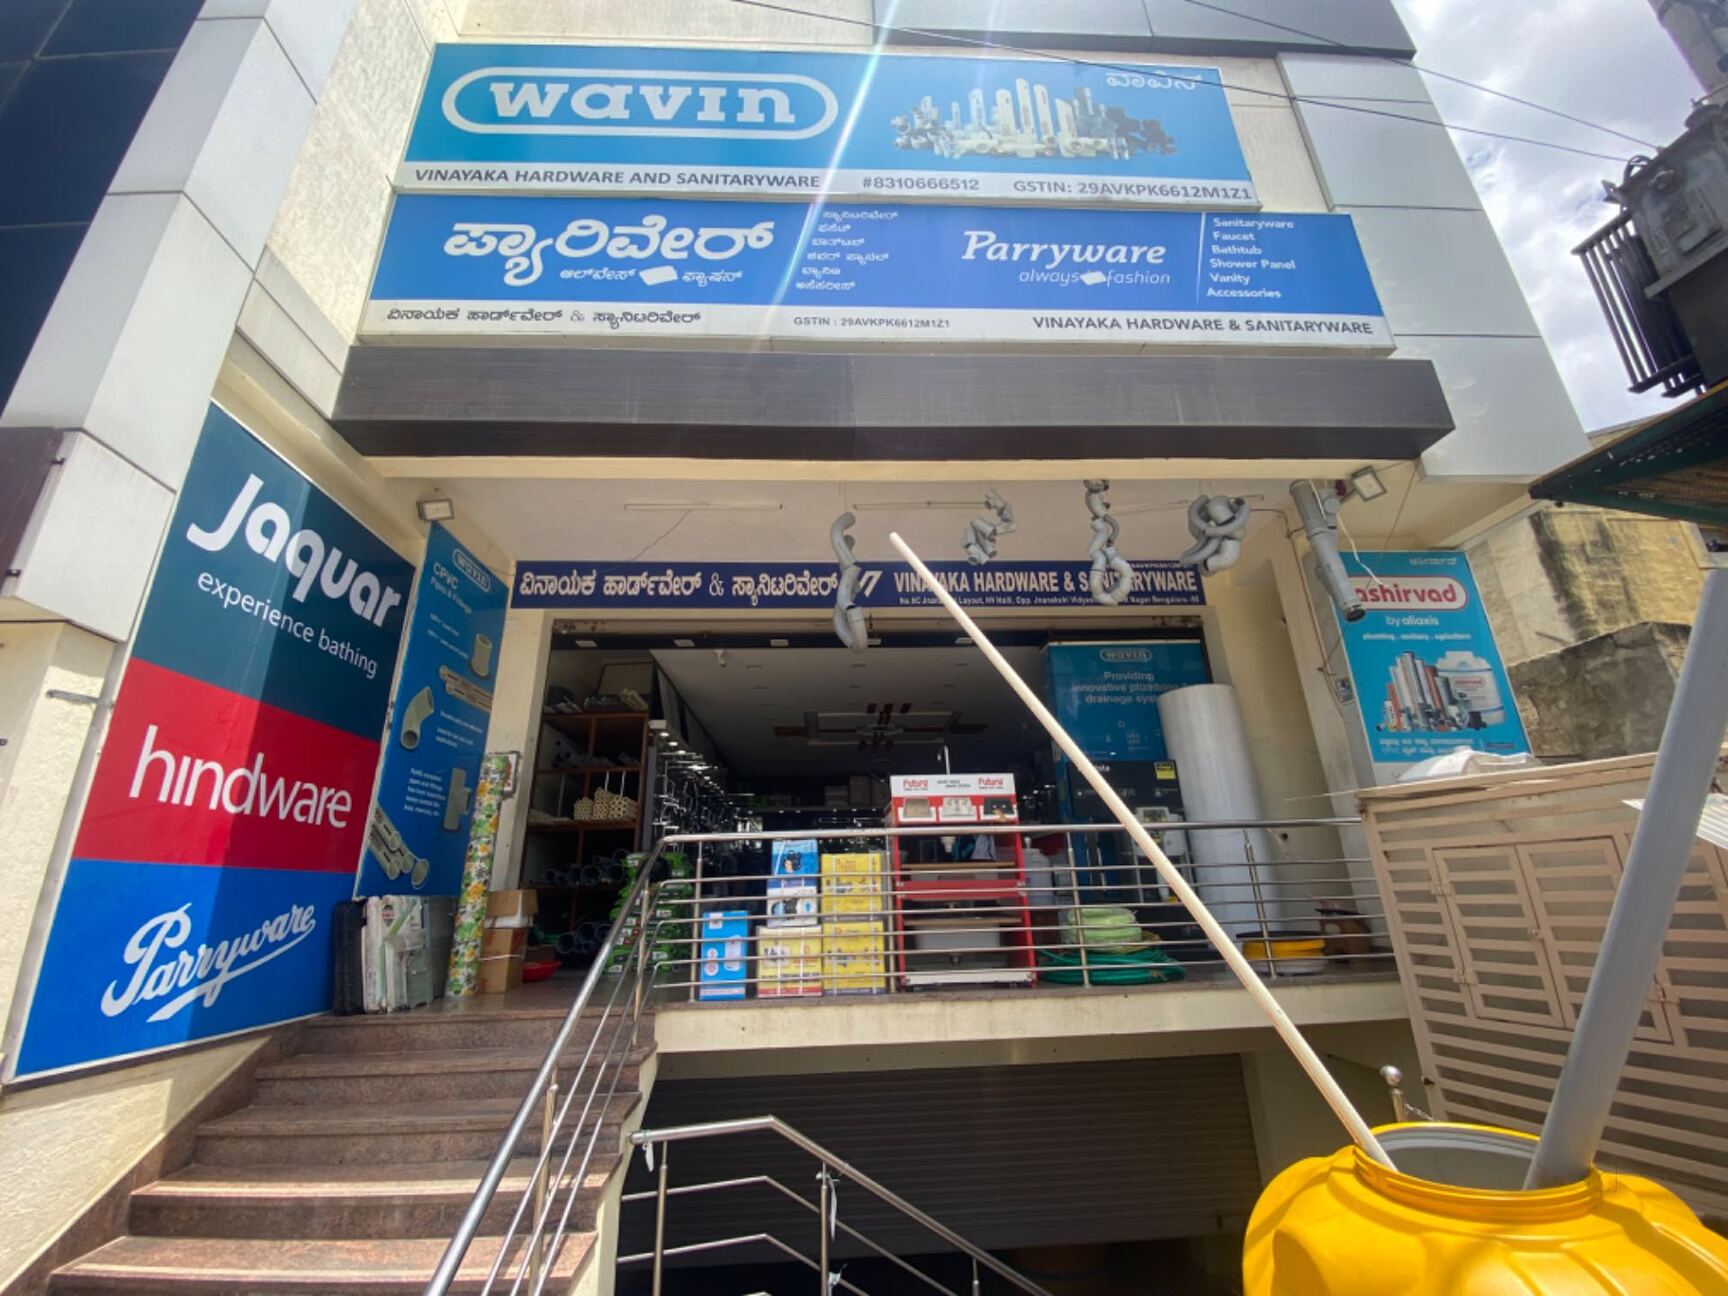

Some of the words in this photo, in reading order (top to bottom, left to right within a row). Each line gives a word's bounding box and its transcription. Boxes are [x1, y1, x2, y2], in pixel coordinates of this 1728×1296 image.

[489, 81, 796, 125] wavin
[415, 168, 510, 183] VINAYAKA
[515, 170, 625, 185] HARDWARE
[629, 172, 672, 186] AND
[676, 172, 820, 188] SANITARYWARE
[862, 175, 980, 192] #8310666512
[1013, 180, 1072, 195] GSTIN:
[1077, 182, 1252, 201] 29AVKPK6612M1Z1
[1213, 217, 1295, 230] Sanitaryware
[1213, 231, 1256, 241] Faucet
[443, 214, 775, 287] ಪ್ಯಾರಿವೇರ್
[962, 230, 1166, 269] Parryware
[1211, 244, 1263, 255] Bathtub
[1209, 258, 1258, 269] Shower
[1260, 259, 1297, 270] Panel
[1019, 269, 1082, 289] always
[1105, 269, 1171, 287] fashion
[1209, 272, 1251, 286] Vanity
[1206, 287, 1282, 298] Accessories
[386, 307, 461, 321] ವಿನಾಯಕ
[570, 310, 586, 323] &
[793, 316, 831, 326] GSTIN
[1032, 315, 1122, 330] VINAYAKA
[1127, 317, 1226, 332] HARDWARE
[1229, 319, 1242, 332] &
[1245, 320, 1375, 336] SANITARYWARE
[186, 473, 402, 628] Jaquar
[518, 568, 598, 597] ವಿನಾಯಕ
[709, 572, 724, 597] &
[893, 571, 970, 593] VINAKA
[973, 571, 1058, 593] HARDWARE
[1064, 571, 1076, 593] &
[198, 571, 315, 643] experience
[317, 627, 379, 680] bathing
[1103, 671, 1155, 682] Providing
[1085, 694, 1133, 705] drainage
[129, 724, 353, 829] hindware
[101, 902, 316, 1022] Parryware
